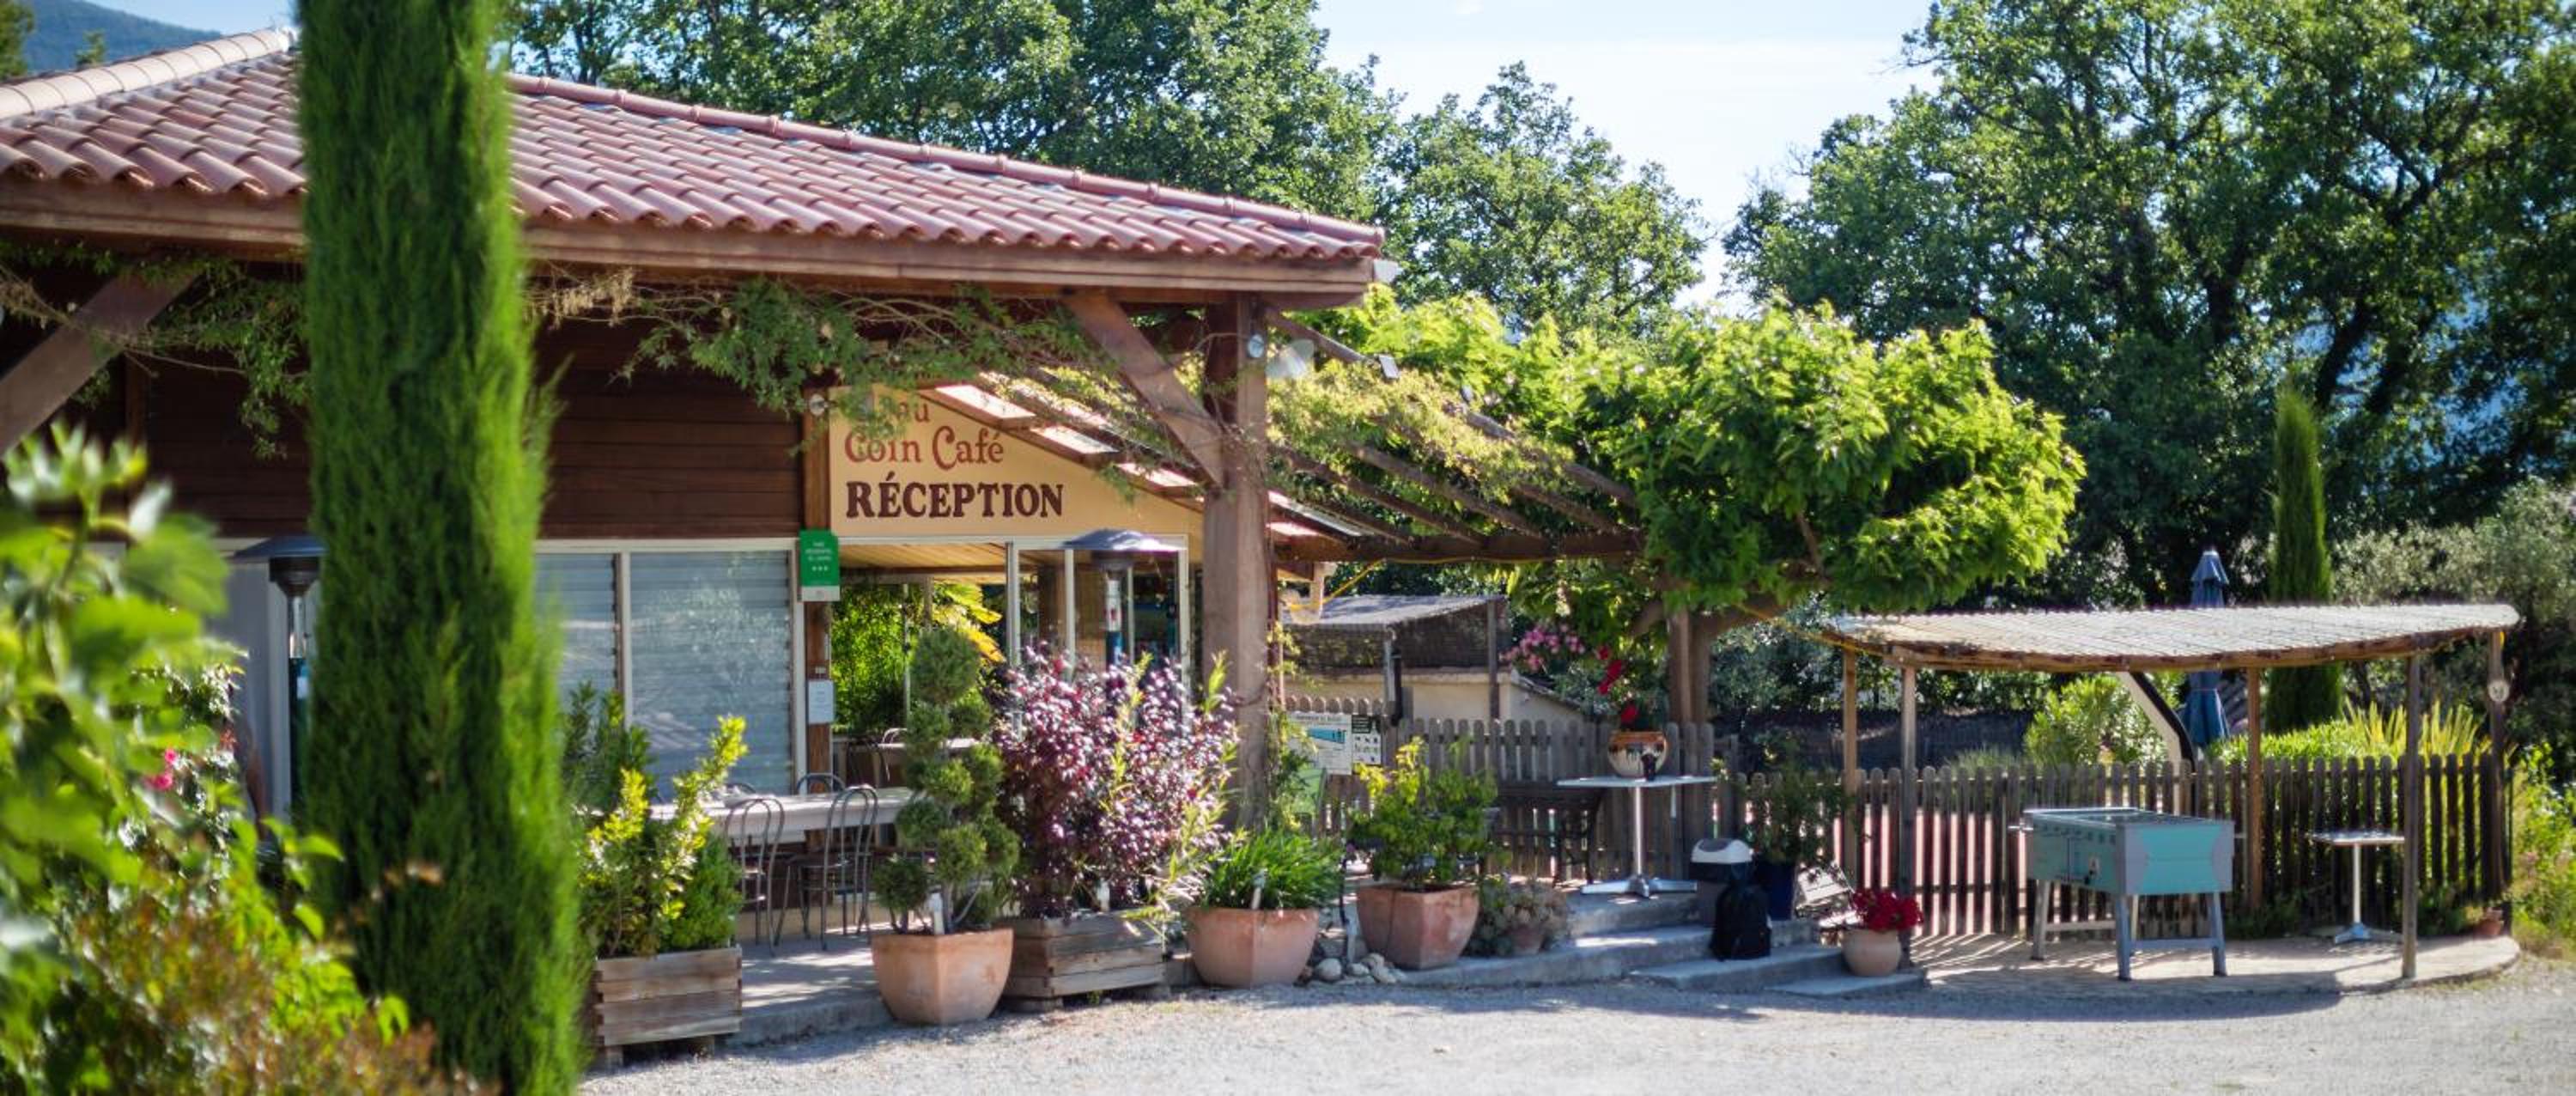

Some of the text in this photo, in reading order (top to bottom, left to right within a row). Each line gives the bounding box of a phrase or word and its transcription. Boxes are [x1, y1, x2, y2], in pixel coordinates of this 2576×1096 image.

[845, 425, 1004, 470] Coin Café
[845, 471, 1063, 518] RÉCEPTION
